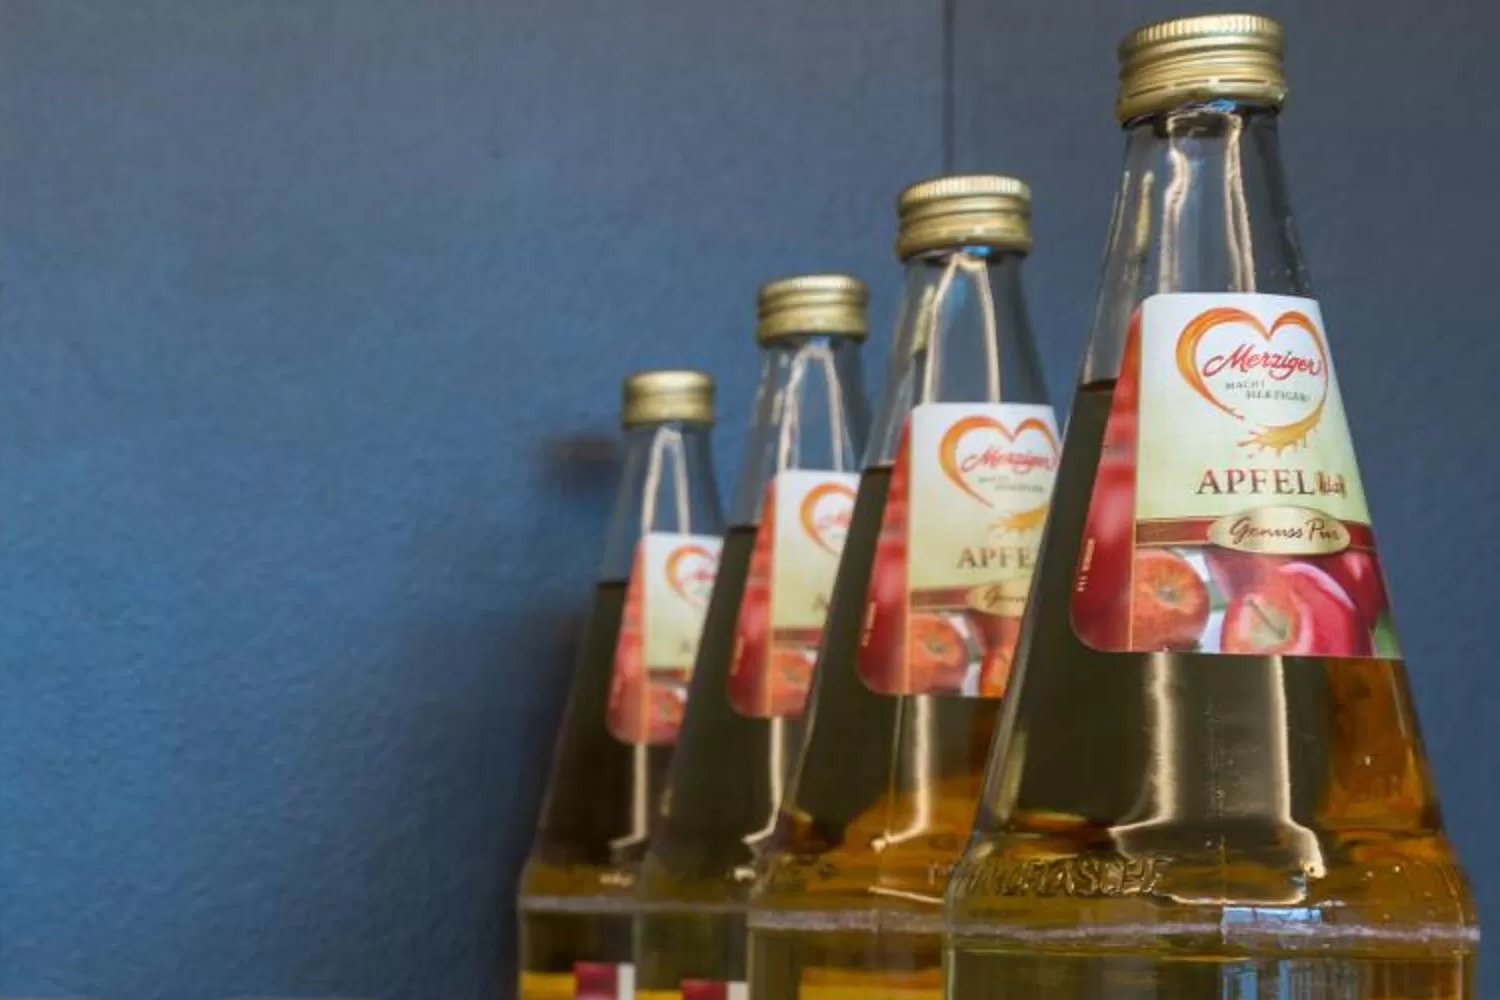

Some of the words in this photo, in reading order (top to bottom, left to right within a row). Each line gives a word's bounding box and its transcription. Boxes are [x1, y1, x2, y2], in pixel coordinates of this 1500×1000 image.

[1203, 344, 1322, 380] Merziger
[1196, 469, 1316, 495] APFEL
[1230, 516, 1303, 543] Genuss
[956, 547, 1033, 570] APFE
